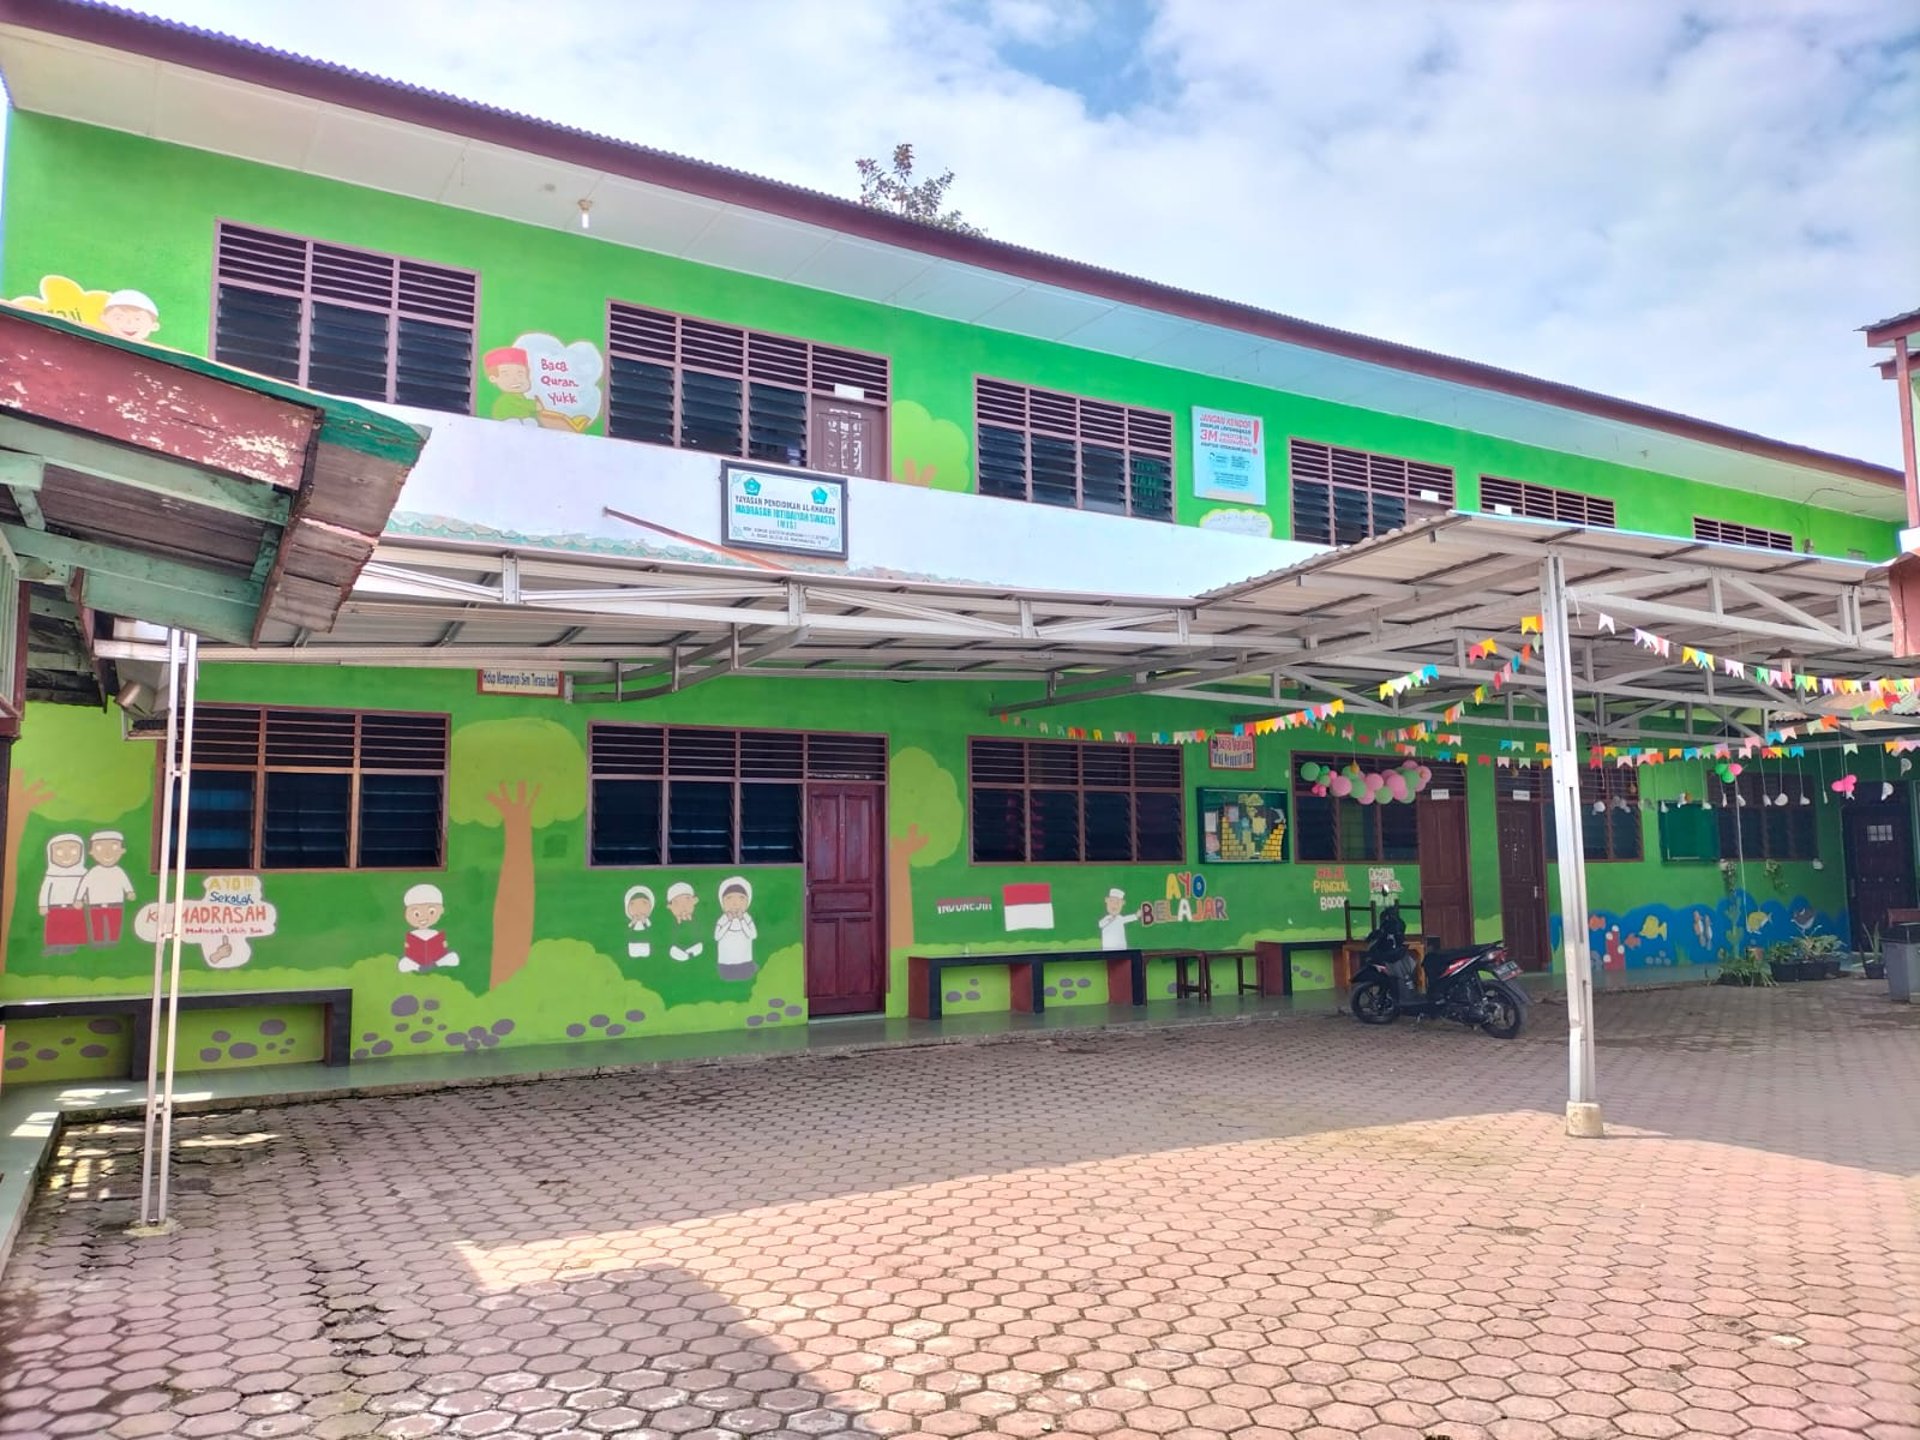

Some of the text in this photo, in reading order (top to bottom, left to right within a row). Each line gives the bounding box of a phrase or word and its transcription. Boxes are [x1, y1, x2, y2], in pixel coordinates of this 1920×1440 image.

[540, 358, 568, 372] Baca
[540, 375, 576, 388] Quran
[547, 391, 577, 406] Yukk
[1200, 428, 1217, 441] 3M
[735, 495, 763, 506] YAYASAN
[764, 499, 801, 510] PENDIDIKAN
[1166, 871, 1206, 900] AYO
[1141, 896, 1229, 927] BELAJAR
